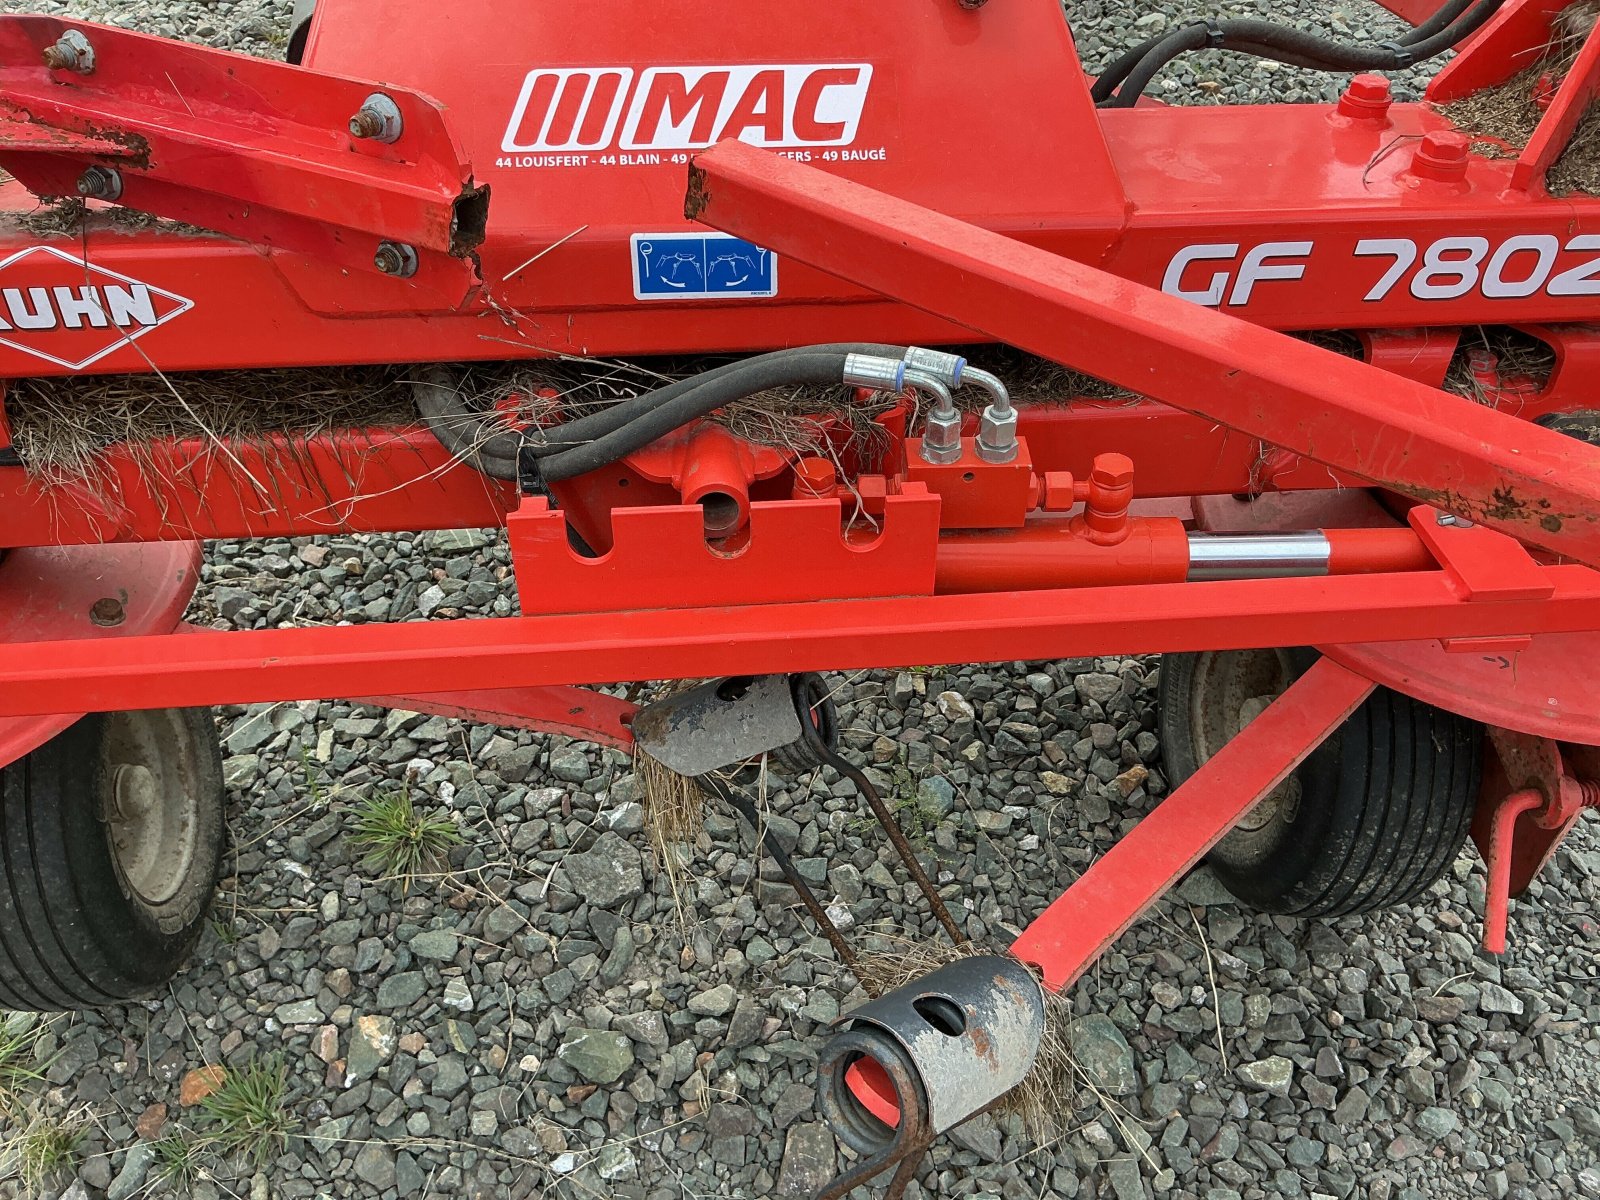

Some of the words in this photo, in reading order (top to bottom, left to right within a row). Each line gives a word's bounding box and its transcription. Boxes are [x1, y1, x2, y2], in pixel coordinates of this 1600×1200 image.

[631, 67, 862, 145] MAC
[495, 157, 513, 168] 44
[515, 155, 589, 167] LOUISFERT
[600, 155, 616, 166] 44
[619, 154, 660, 165] BLAIN
[671, 153, 687, 164] 49
[822, 150, 838, 161] 49
[842, 147, 887, 160] BAUGÉ
[1161, 241, 1313, 306] GF
[1354, 234, 1600, 300] 7802
